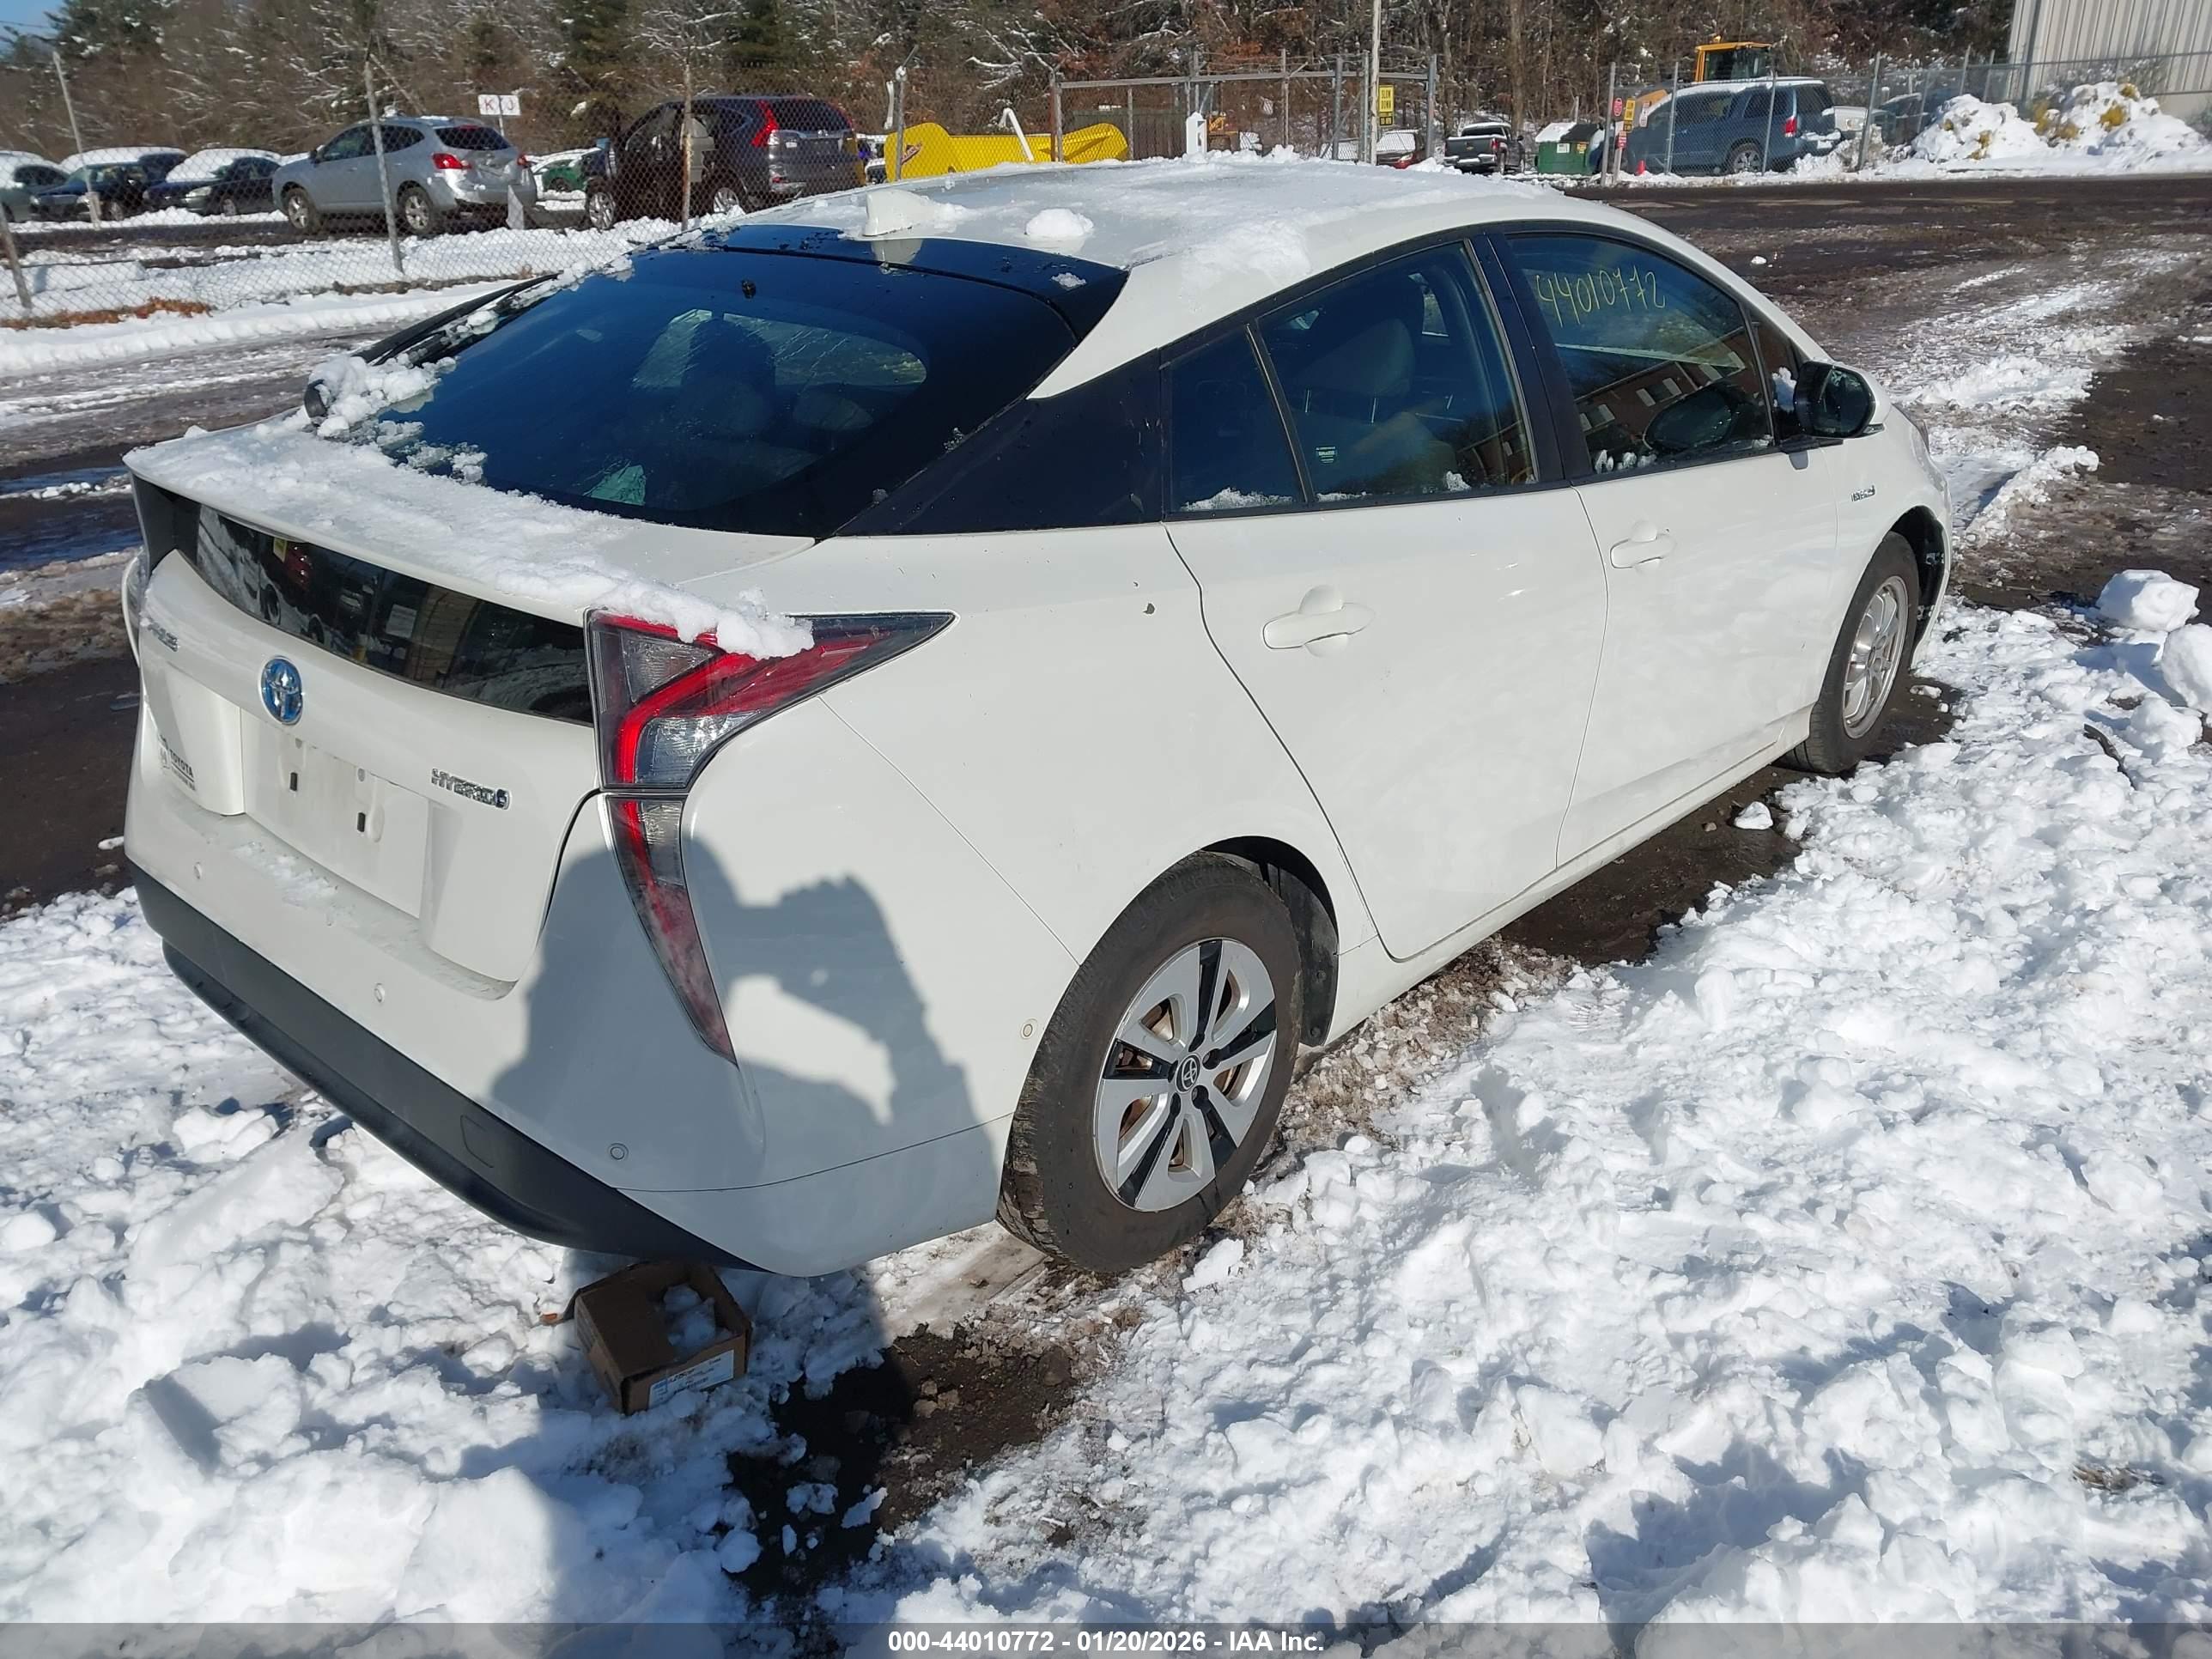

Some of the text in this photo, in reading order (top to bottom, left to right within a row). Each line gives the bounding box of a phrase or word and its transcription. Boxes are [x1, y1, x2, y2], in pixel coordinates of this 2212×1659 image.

[483, 99, 515, 111] K J
[1536, 264, 1665, 328] 44010772
[169, 748, 194, 779] TOYOTA
[431, 768, 496, 806] HYBRID
